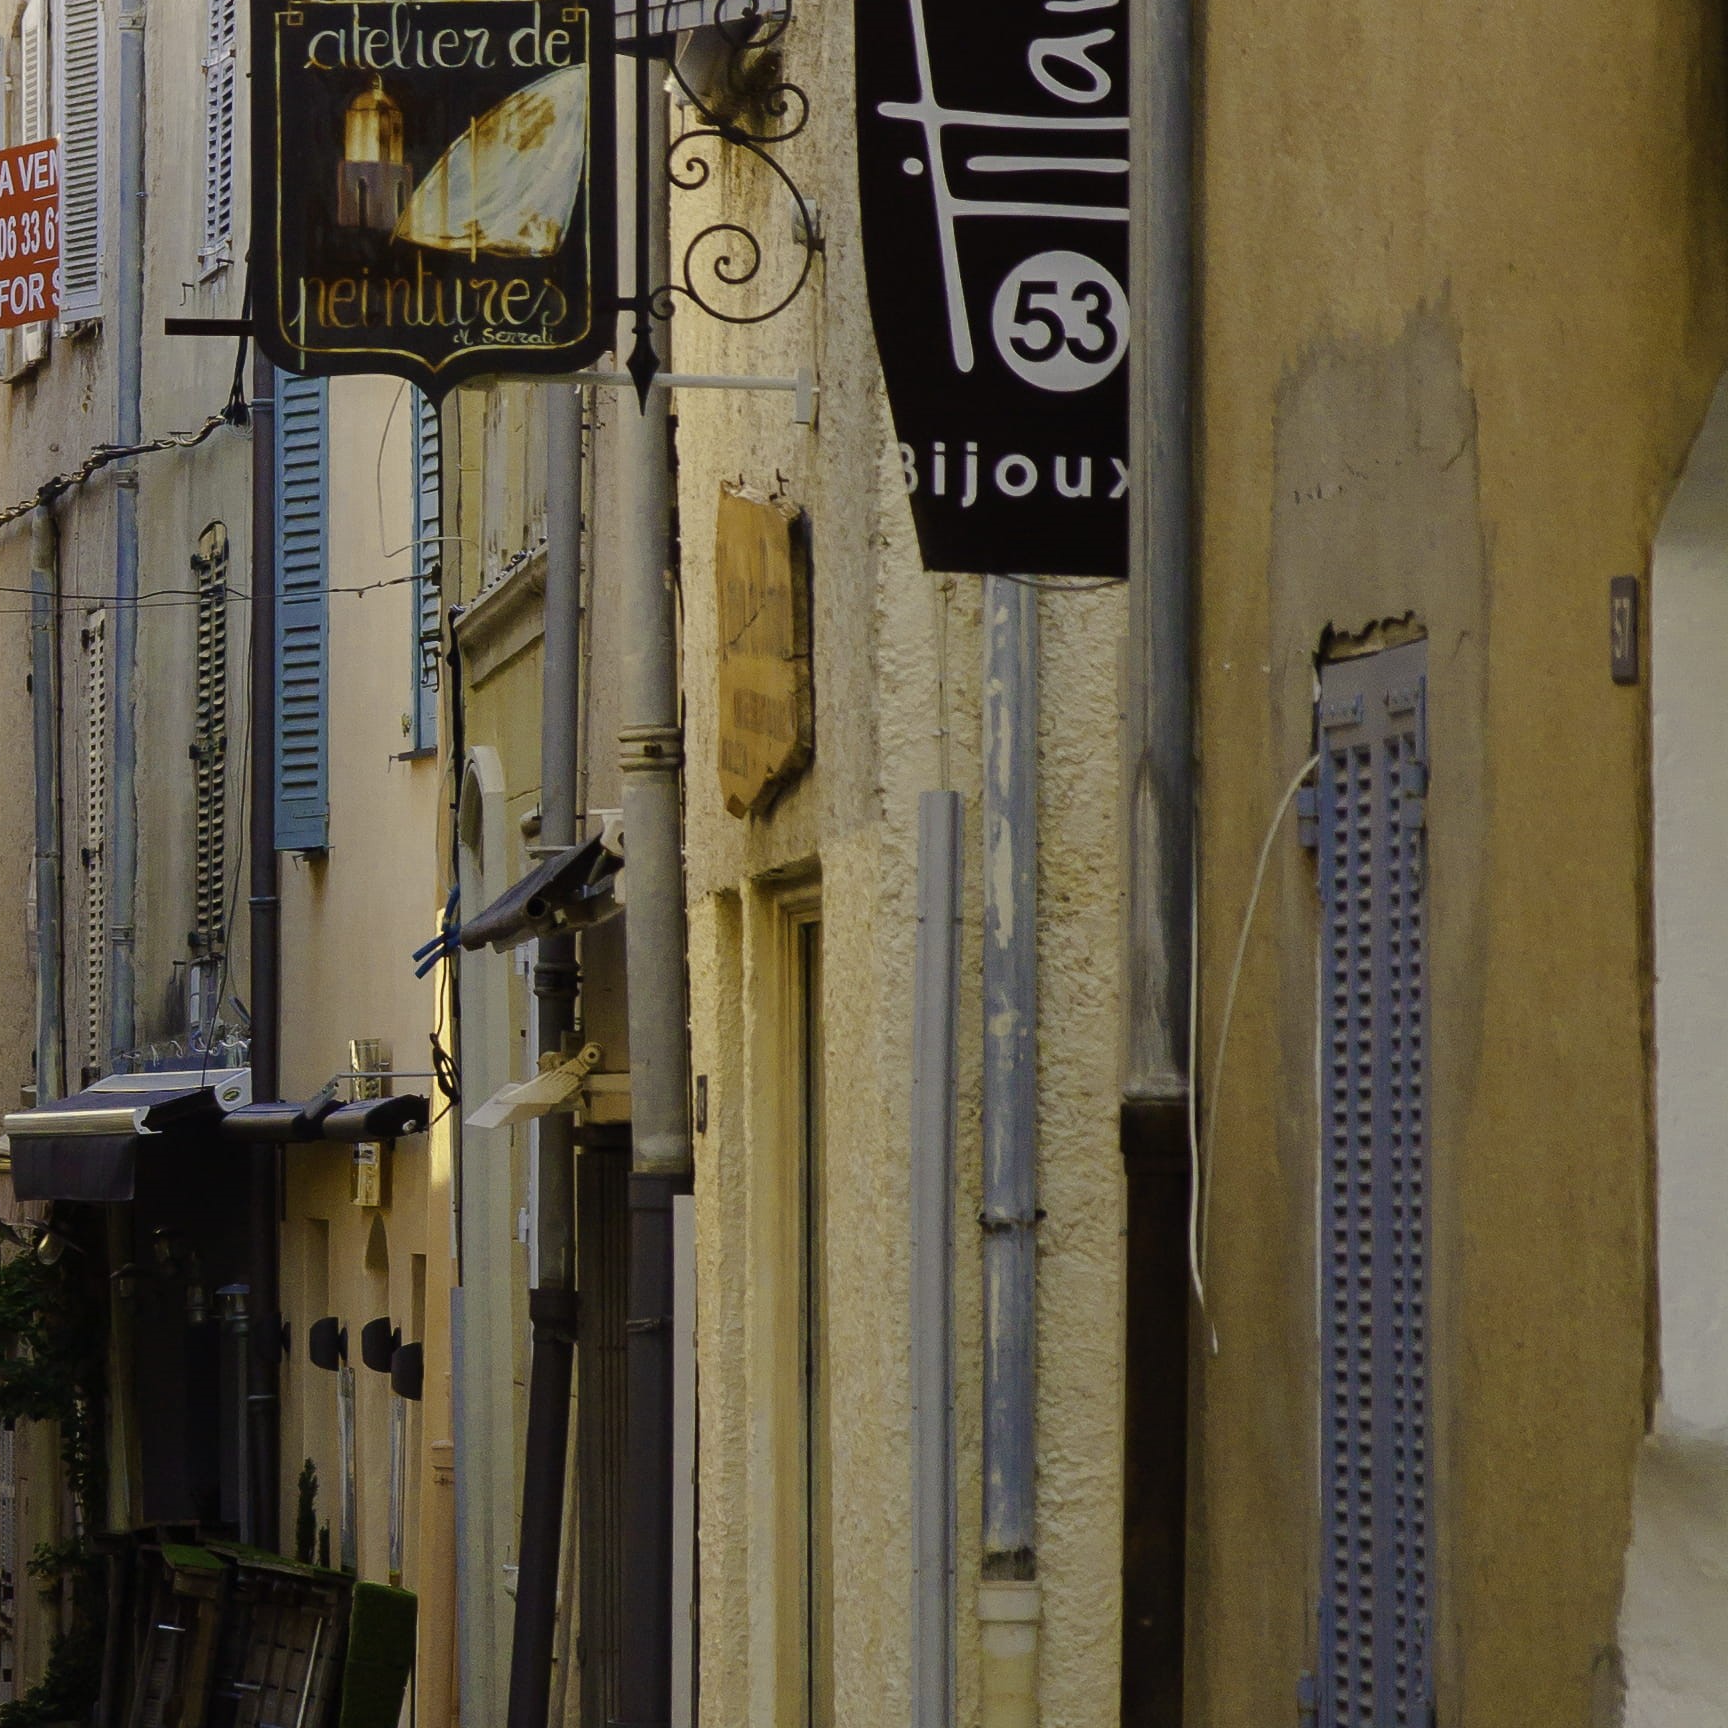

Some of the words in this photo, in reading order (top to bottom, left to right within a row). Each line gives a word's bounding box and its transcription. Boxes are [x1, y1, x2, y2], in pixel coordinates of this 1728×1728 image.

[304, 3, 496, 70] atelier
[508, 1, 571, 68] de
[21, 210, 40, 256] 33
[1009, 279, 1118, 363] 53
